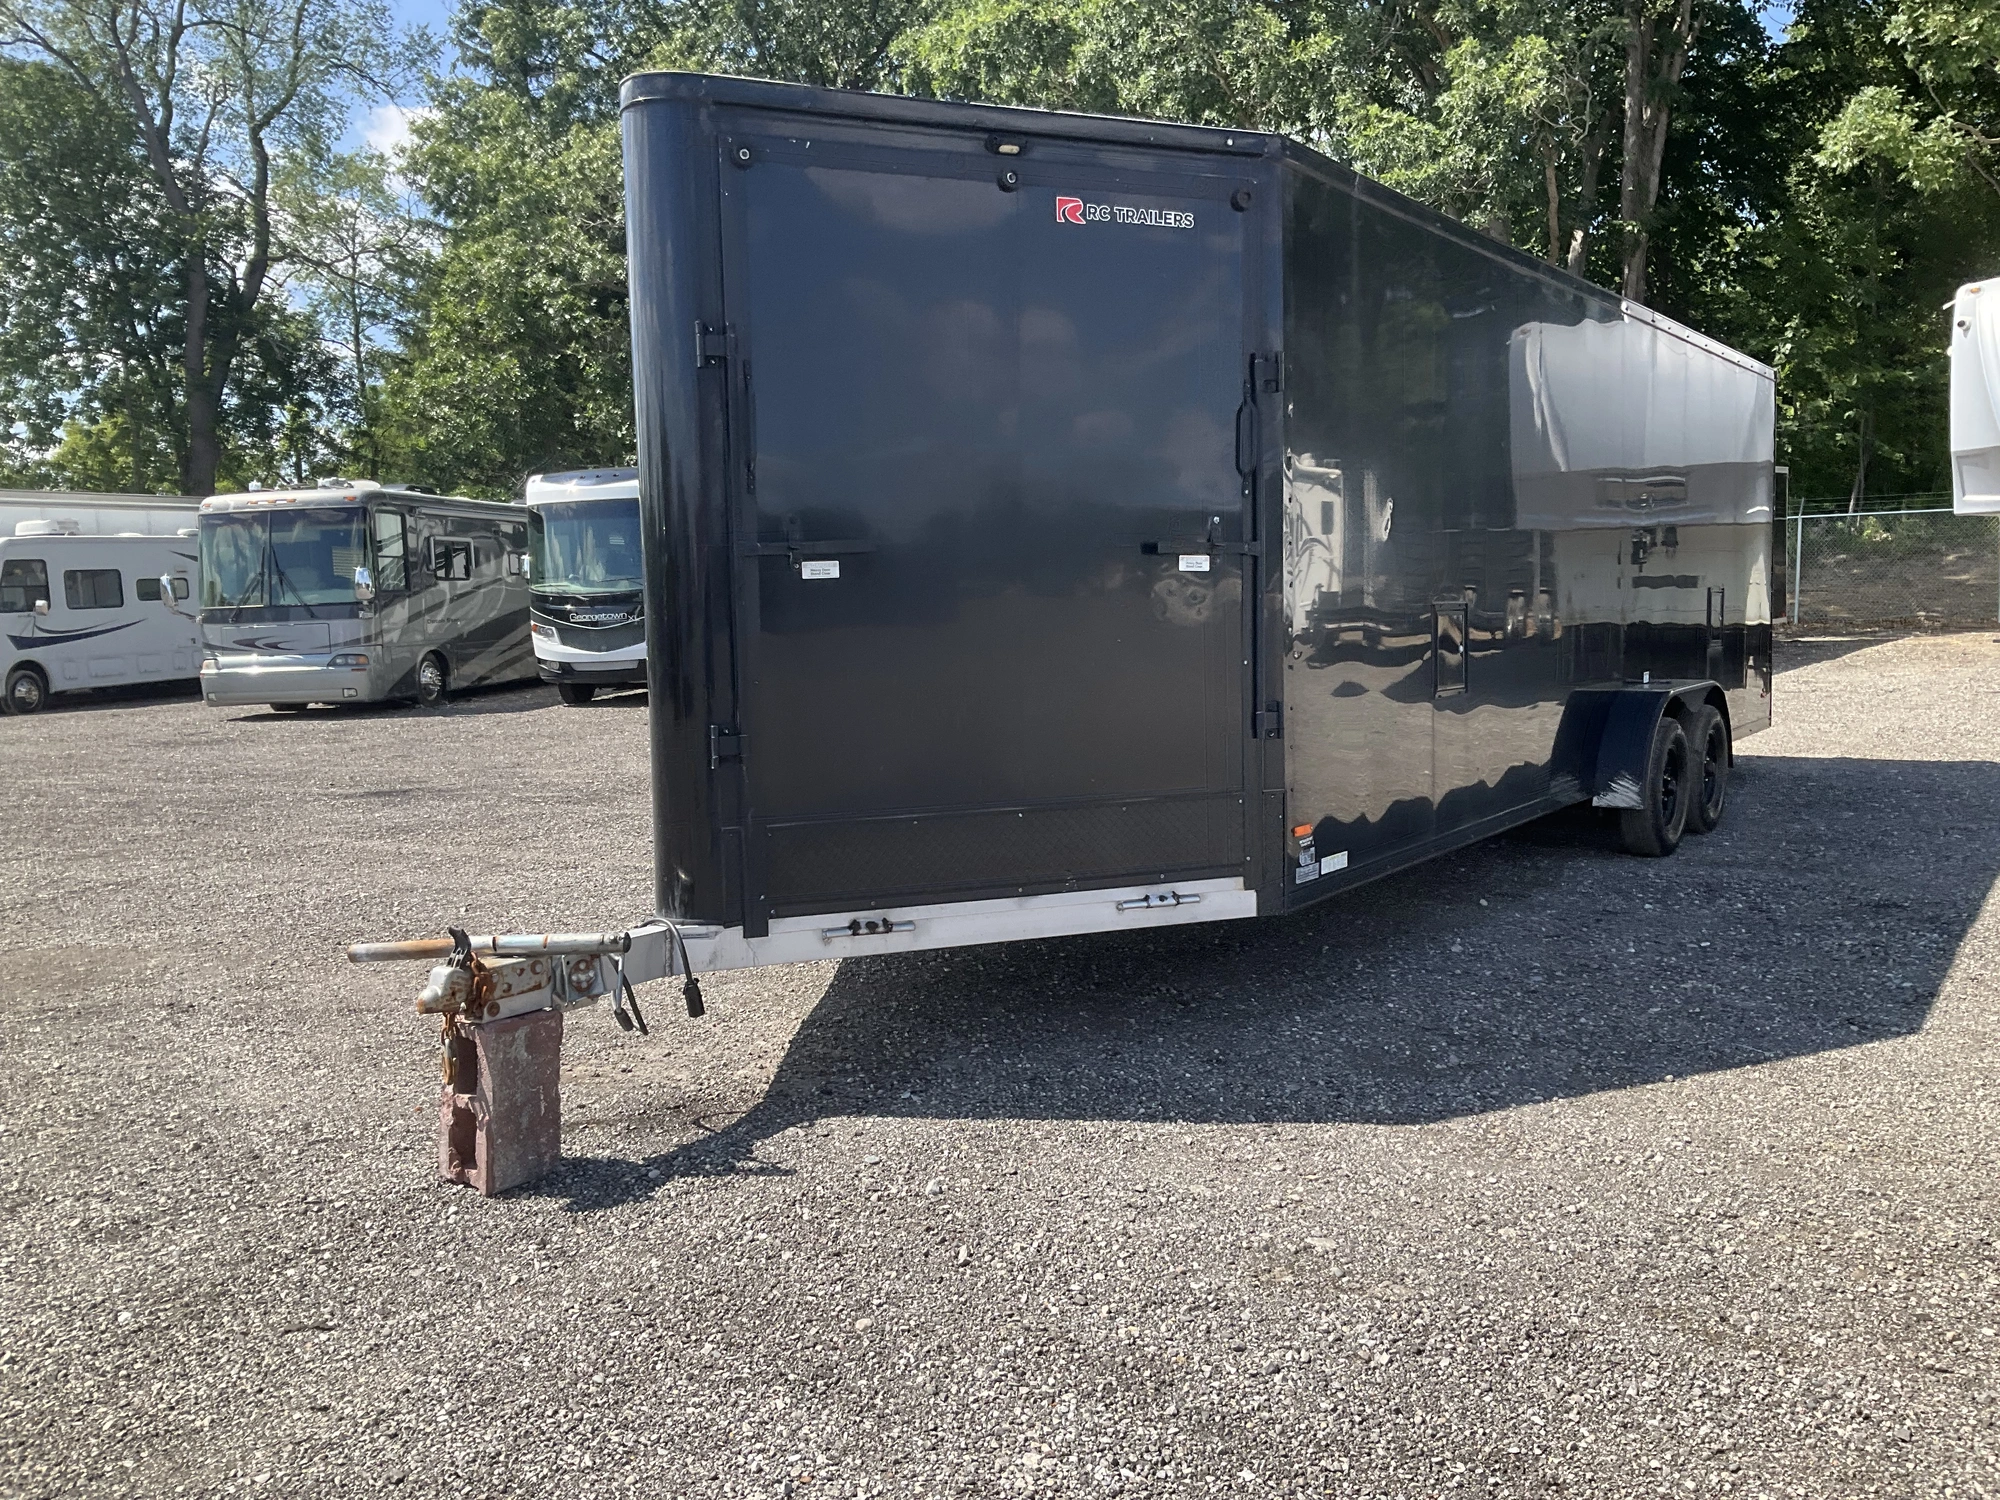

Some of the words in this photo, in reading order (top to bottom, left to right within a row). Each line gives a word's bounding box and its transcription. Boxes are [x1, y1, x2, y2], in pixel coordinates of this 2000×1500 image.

[1086, 204, 1110, 221] RC
[1114, 206, 1194, 228] TRAILERS
[569, 612, 627, 622] Georgetown
